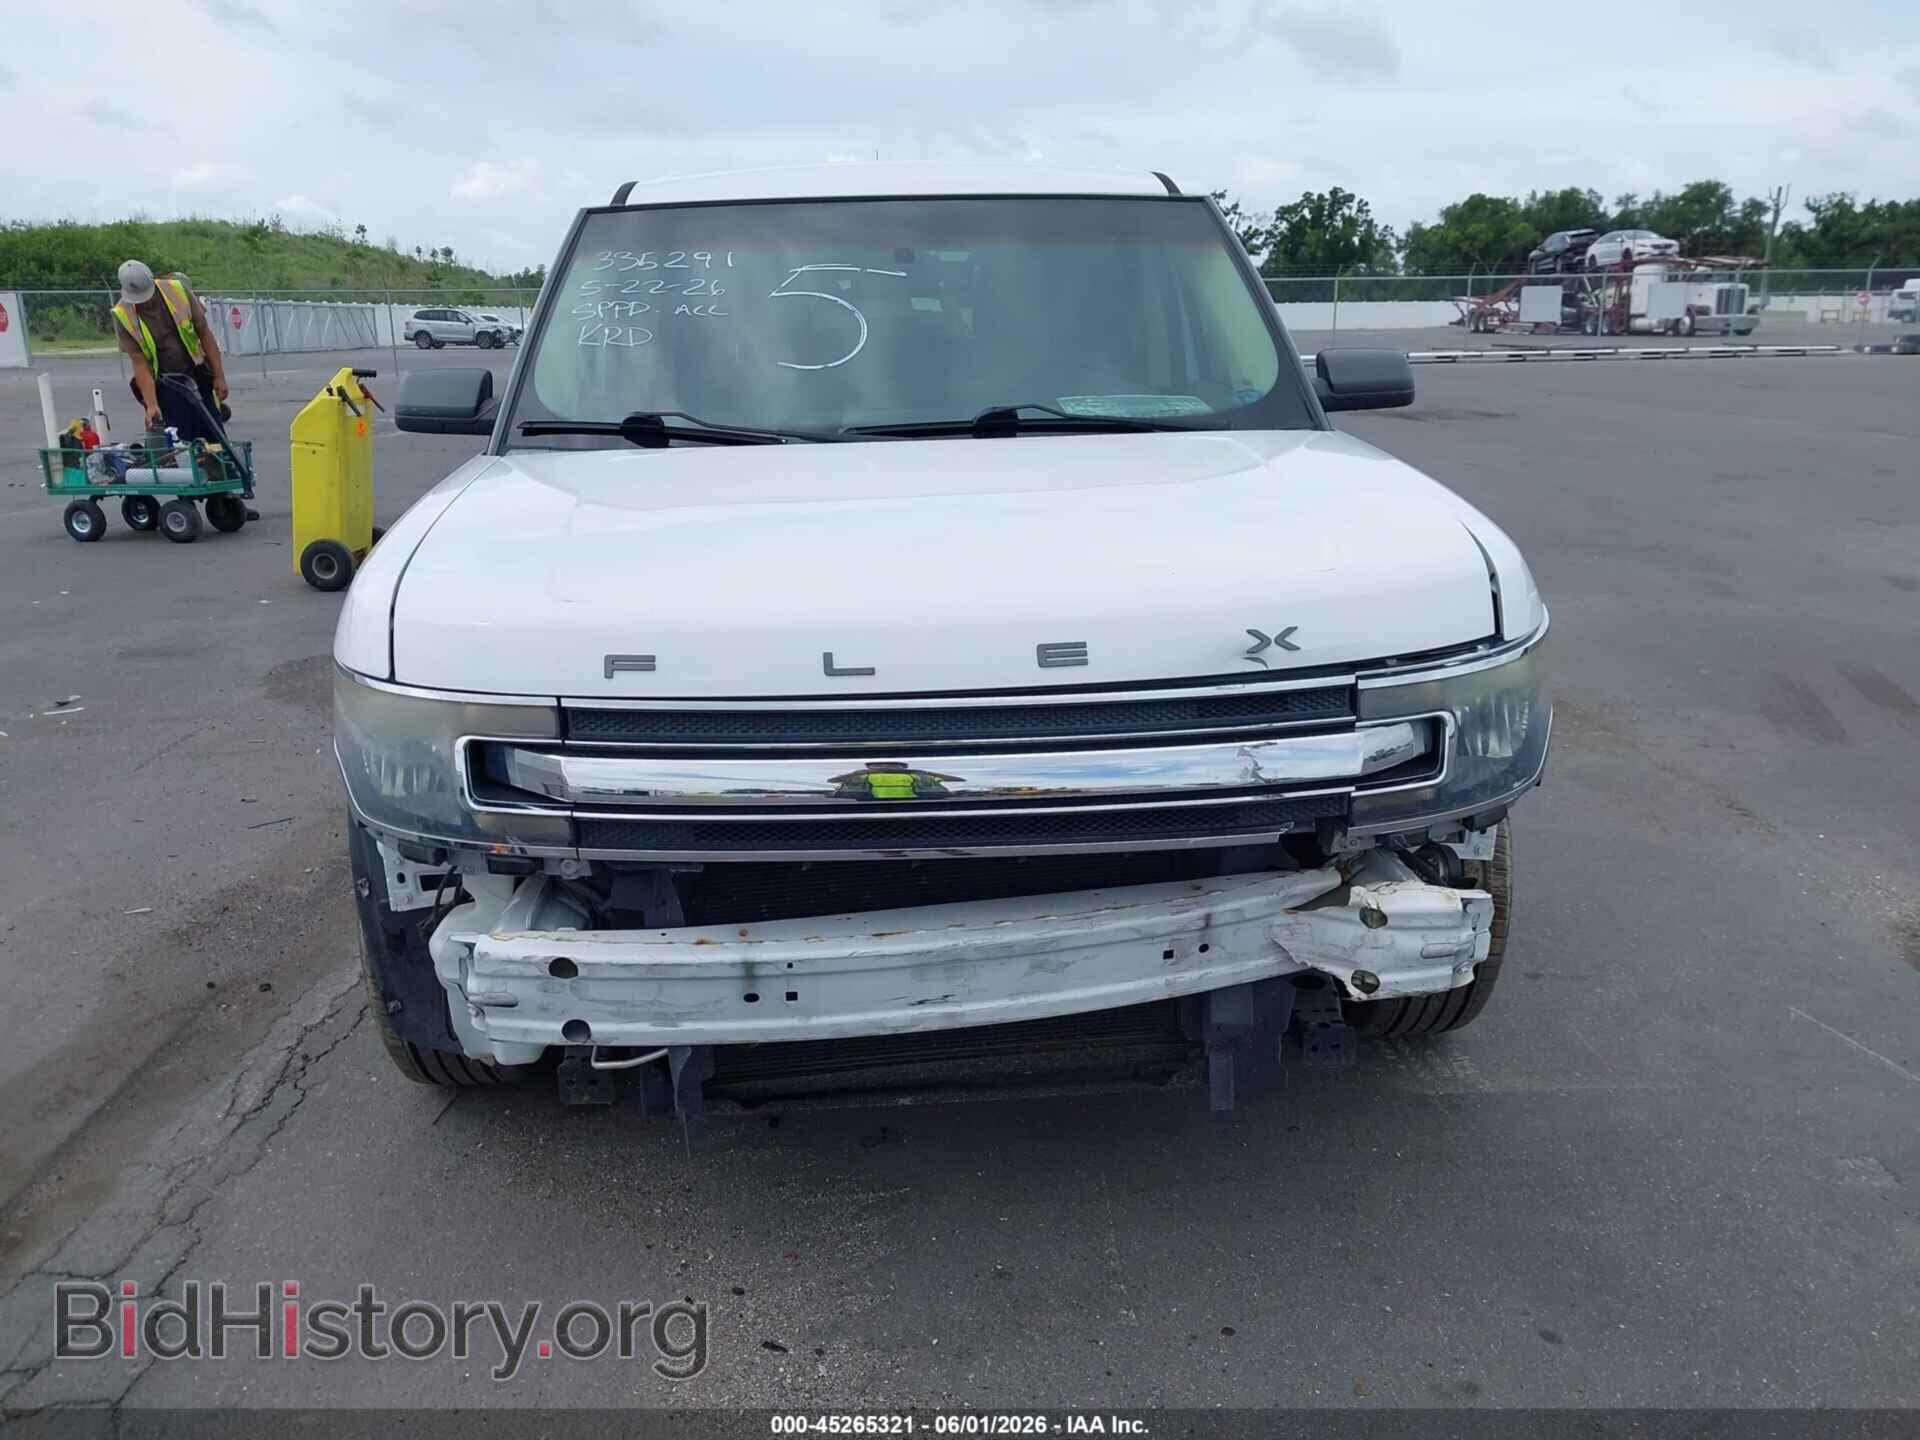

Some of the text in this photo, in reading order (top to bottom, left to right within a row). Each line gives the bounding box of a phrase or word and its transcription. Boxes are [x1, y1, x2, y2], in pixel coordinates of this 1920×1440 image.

[580, 279, 726, 296] 5-22-26
[768, 263, 907, 369] 5
[578, 323, 653, 348] KRD
